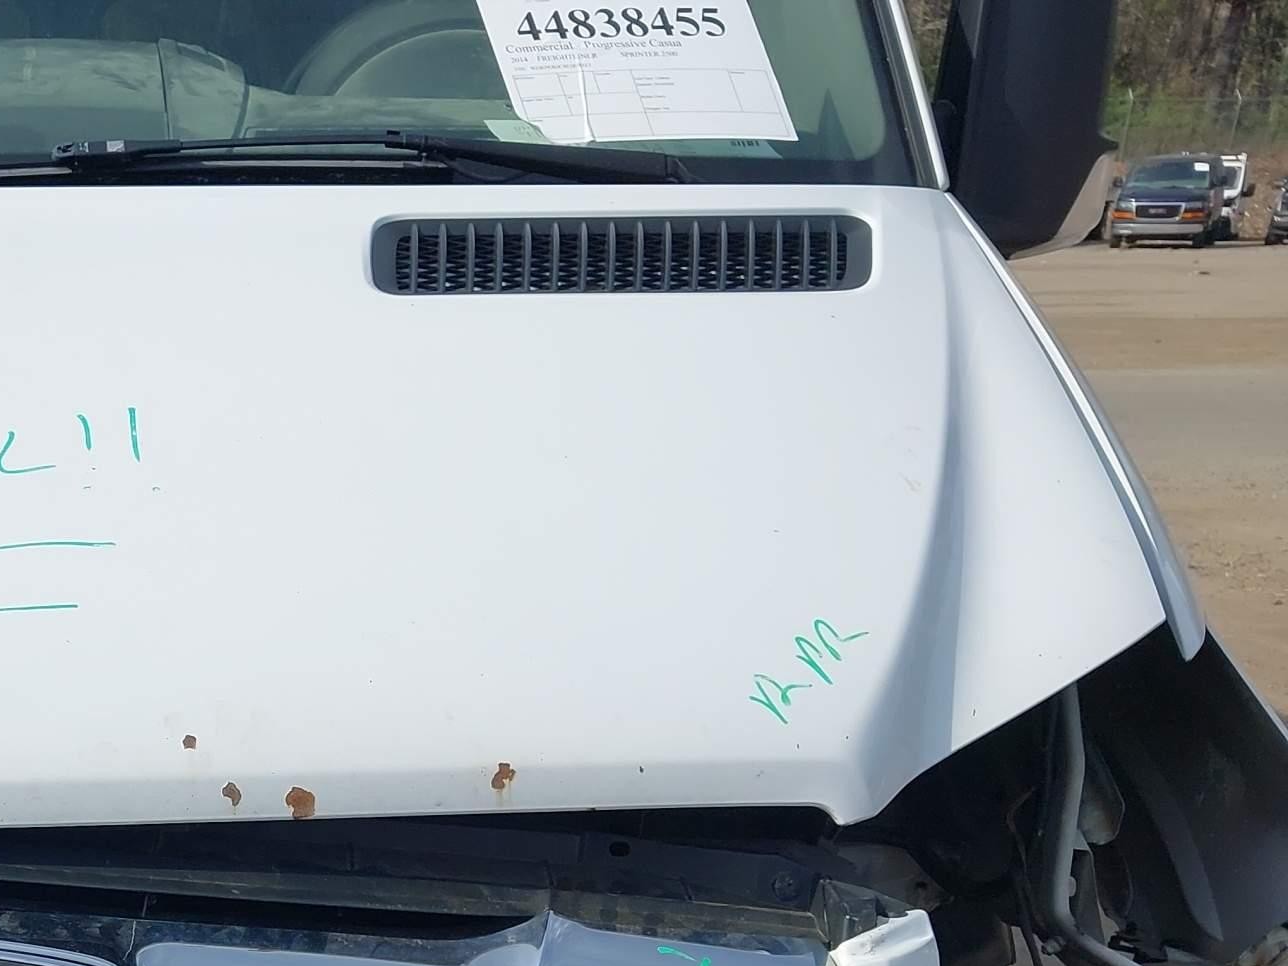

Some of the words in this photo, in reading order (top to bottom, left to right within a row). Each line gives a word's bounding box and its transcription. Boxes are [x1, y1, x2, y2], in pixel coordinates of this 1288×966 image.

[516, 7, 726, 41] 44838455
[505, 40, 574, 54] Commercial
[584, 38, 647, 49] Progressive
[649, 37, 682, 48] Casua
